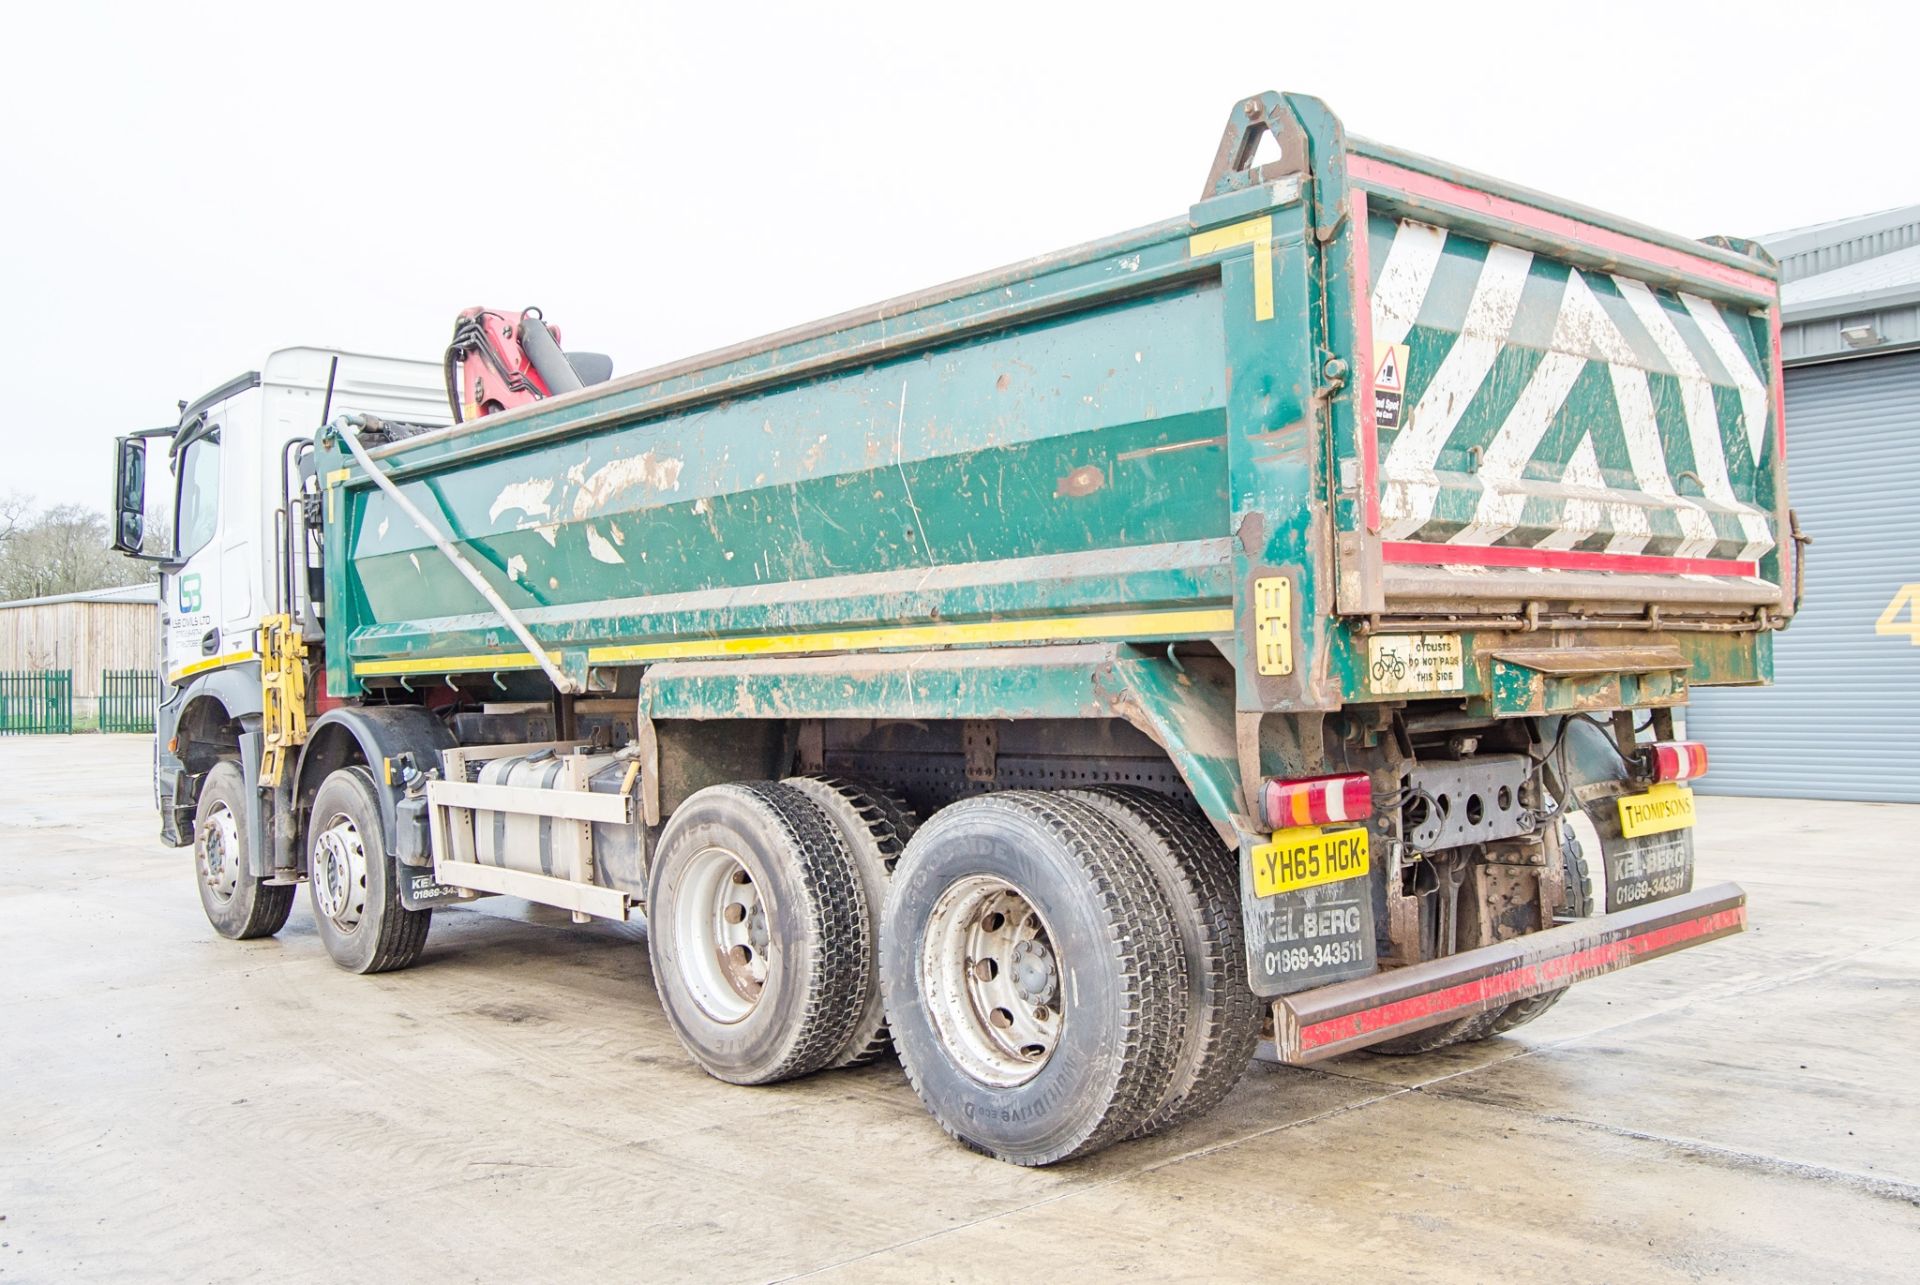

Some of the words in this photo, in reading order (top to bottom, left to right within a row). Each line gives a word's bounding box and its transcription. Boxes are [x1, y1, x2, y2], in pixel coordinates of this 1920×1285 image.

[1415, 643, 1452, 653] CYCLISTS
[1422, 656, 1438, 666] NOT
[1439, 656, 1460, 667] PASS
[1416, 672, 1434, 682] THIS
[1436, 671, 1454, 681] SIDE
[1625, 797, 1692, 828] THOMPSONS
[1265, 844, 1320, 885] YH65
[1325, 836, 1362, 875] HGK
[1615, 872, 1685, 905] 01869-343511
[1264, 906, 1361, 944] KEL-BERG
[1264, 939, 1363, 976] 01869-343511
